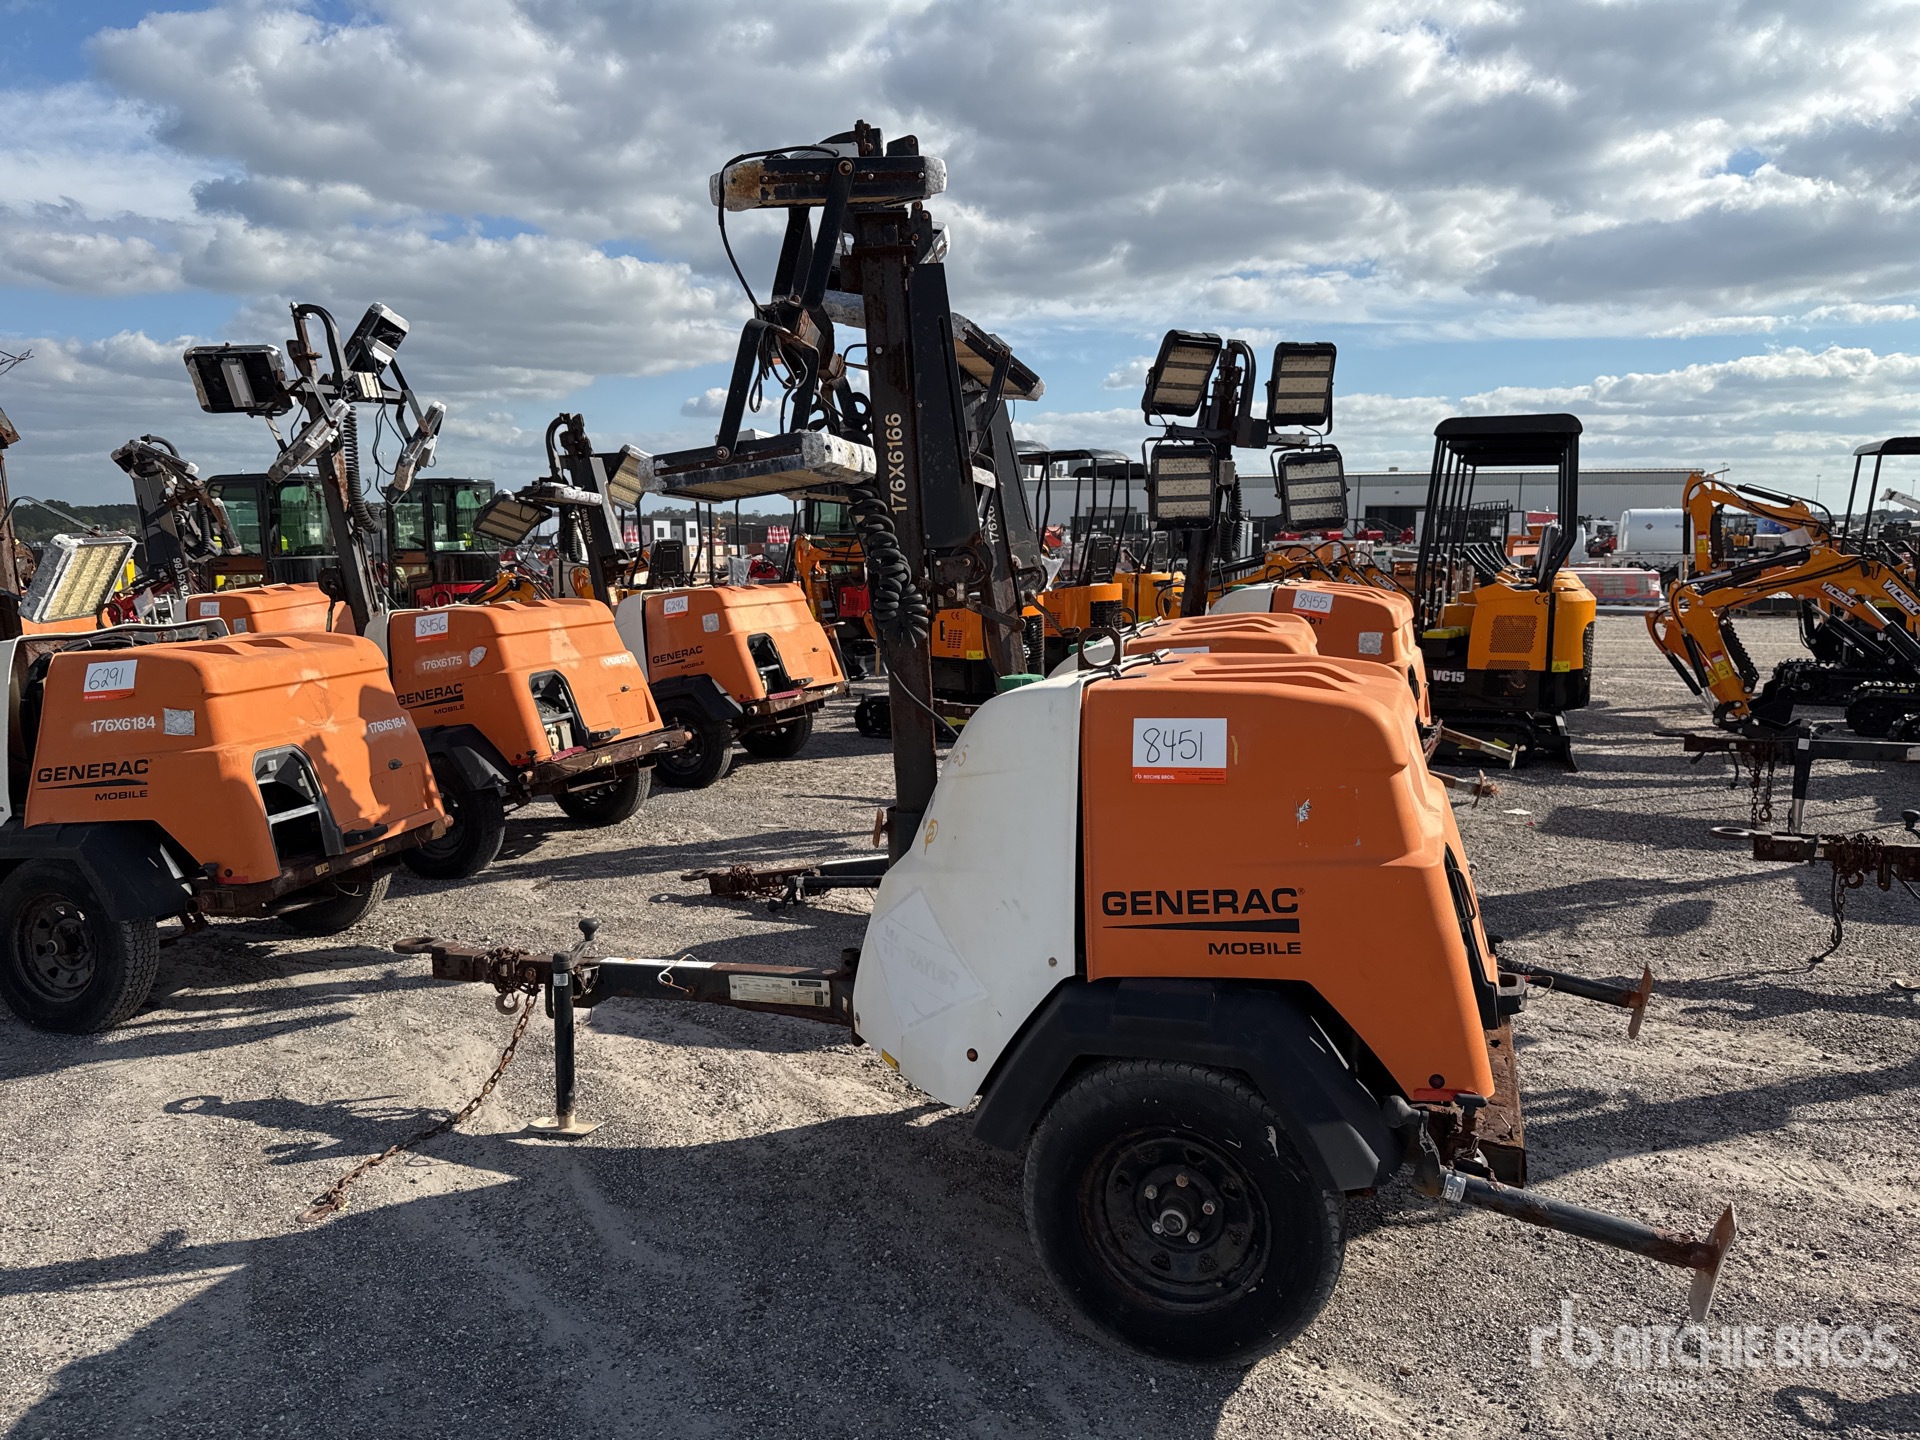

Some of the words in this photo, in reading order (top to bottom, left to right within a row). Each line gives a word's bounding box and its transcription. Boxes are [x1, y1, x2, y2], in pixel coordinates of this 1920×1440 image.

[885, 413, 908, 515] 176X6166
[1299, 593, 1328, 609] 8455
[1821, 582, 1858, 608] VICSEC
[1882, 578, 1920, 616] VICSEC
[665, 599, 685, 613] 6292
[419, 616, 446, 634] 8456
[422, 655, 463, 670] 176X6175
[652, 645, 704, 664] GENERAC
[681, 661, 705, 670] MOBILE
[89, 667, 124, 690] 6291
[1432, 669, 1465, 683] VC15
[397, 683, 463, 706] GENERAC
[433, 704, 465, 715] MOBILE
[90, 716, 156, 733] 176X6184
[368, 716, 407, 734] 176X6184
[1142, 727, 1203, 763] 8451
[37, 759, 149, 783] GENERAC
[94, 790, 148, 801] MOBILE
[1102, 887, 1299, 916] GENERAC
[1208, 942, 1302, 955] MOBILE
